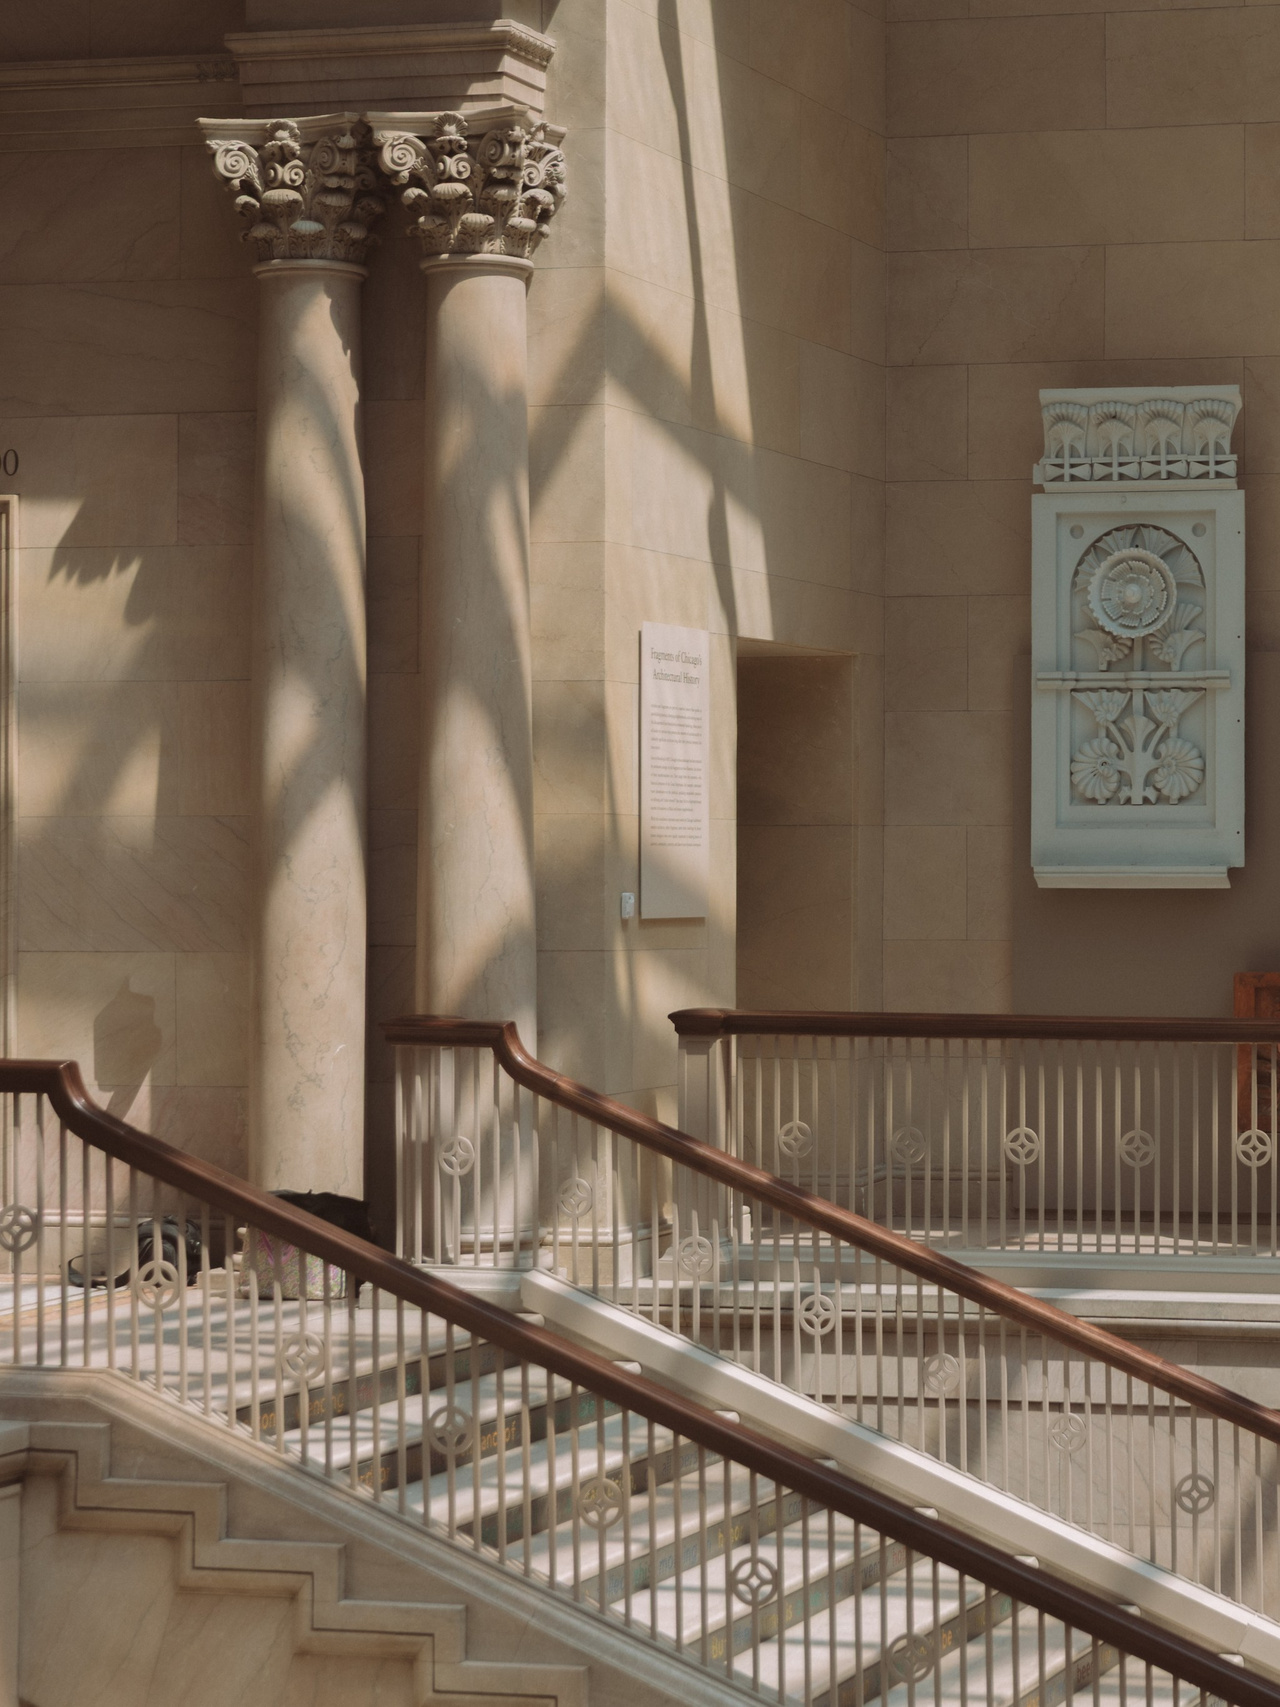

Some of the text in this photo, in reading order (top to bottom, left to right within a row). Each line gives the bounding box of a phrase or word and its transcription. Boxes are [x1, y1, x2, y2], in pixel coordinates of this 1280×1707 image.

[650, 647, 703, 668] Fragments of Chicago's
[652, 668, 700, 688] Architectural History
[1076, 1661, 1097, 1684] bee
